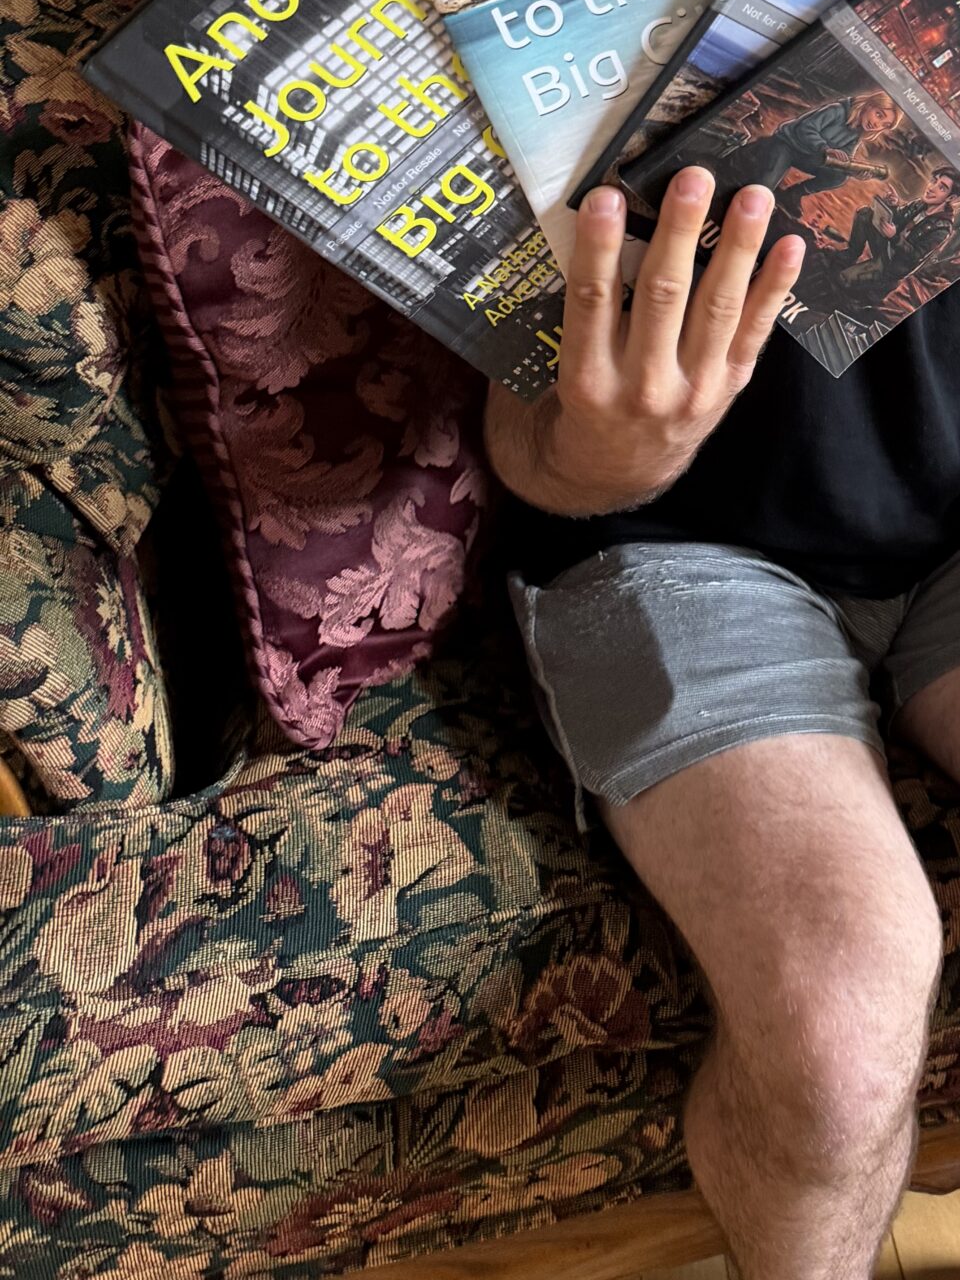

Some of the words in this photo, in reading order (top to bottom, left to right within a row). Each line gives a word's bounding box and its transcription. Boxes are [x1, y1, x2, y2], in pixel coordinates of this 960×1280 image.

[491, 0, 564, 49] to
[741, 2, 762, 20] Not
[762, 13, 776, 27] for
[844, 25, 863, 45] Not
[859, 40, 874, 55] for
[869, 50, 897, 79] Resale
[522, 49, 629, 117] Big
[903, 87, 921, 105] Not
[916, 101, 930, 115] for
[925, 113, 952, 141] Resale
[303, 142, 390, 206] to
[373, 189, 394, 209] Not
[391, 176, 408, 192] for
[406, 146, 442, 179] Resale
[327, 219, 362, 250] Resale
[376, 164, 495, 258] Big
[462, 292, 484, 312] A
[478, 229, 546, 294] Nathan
